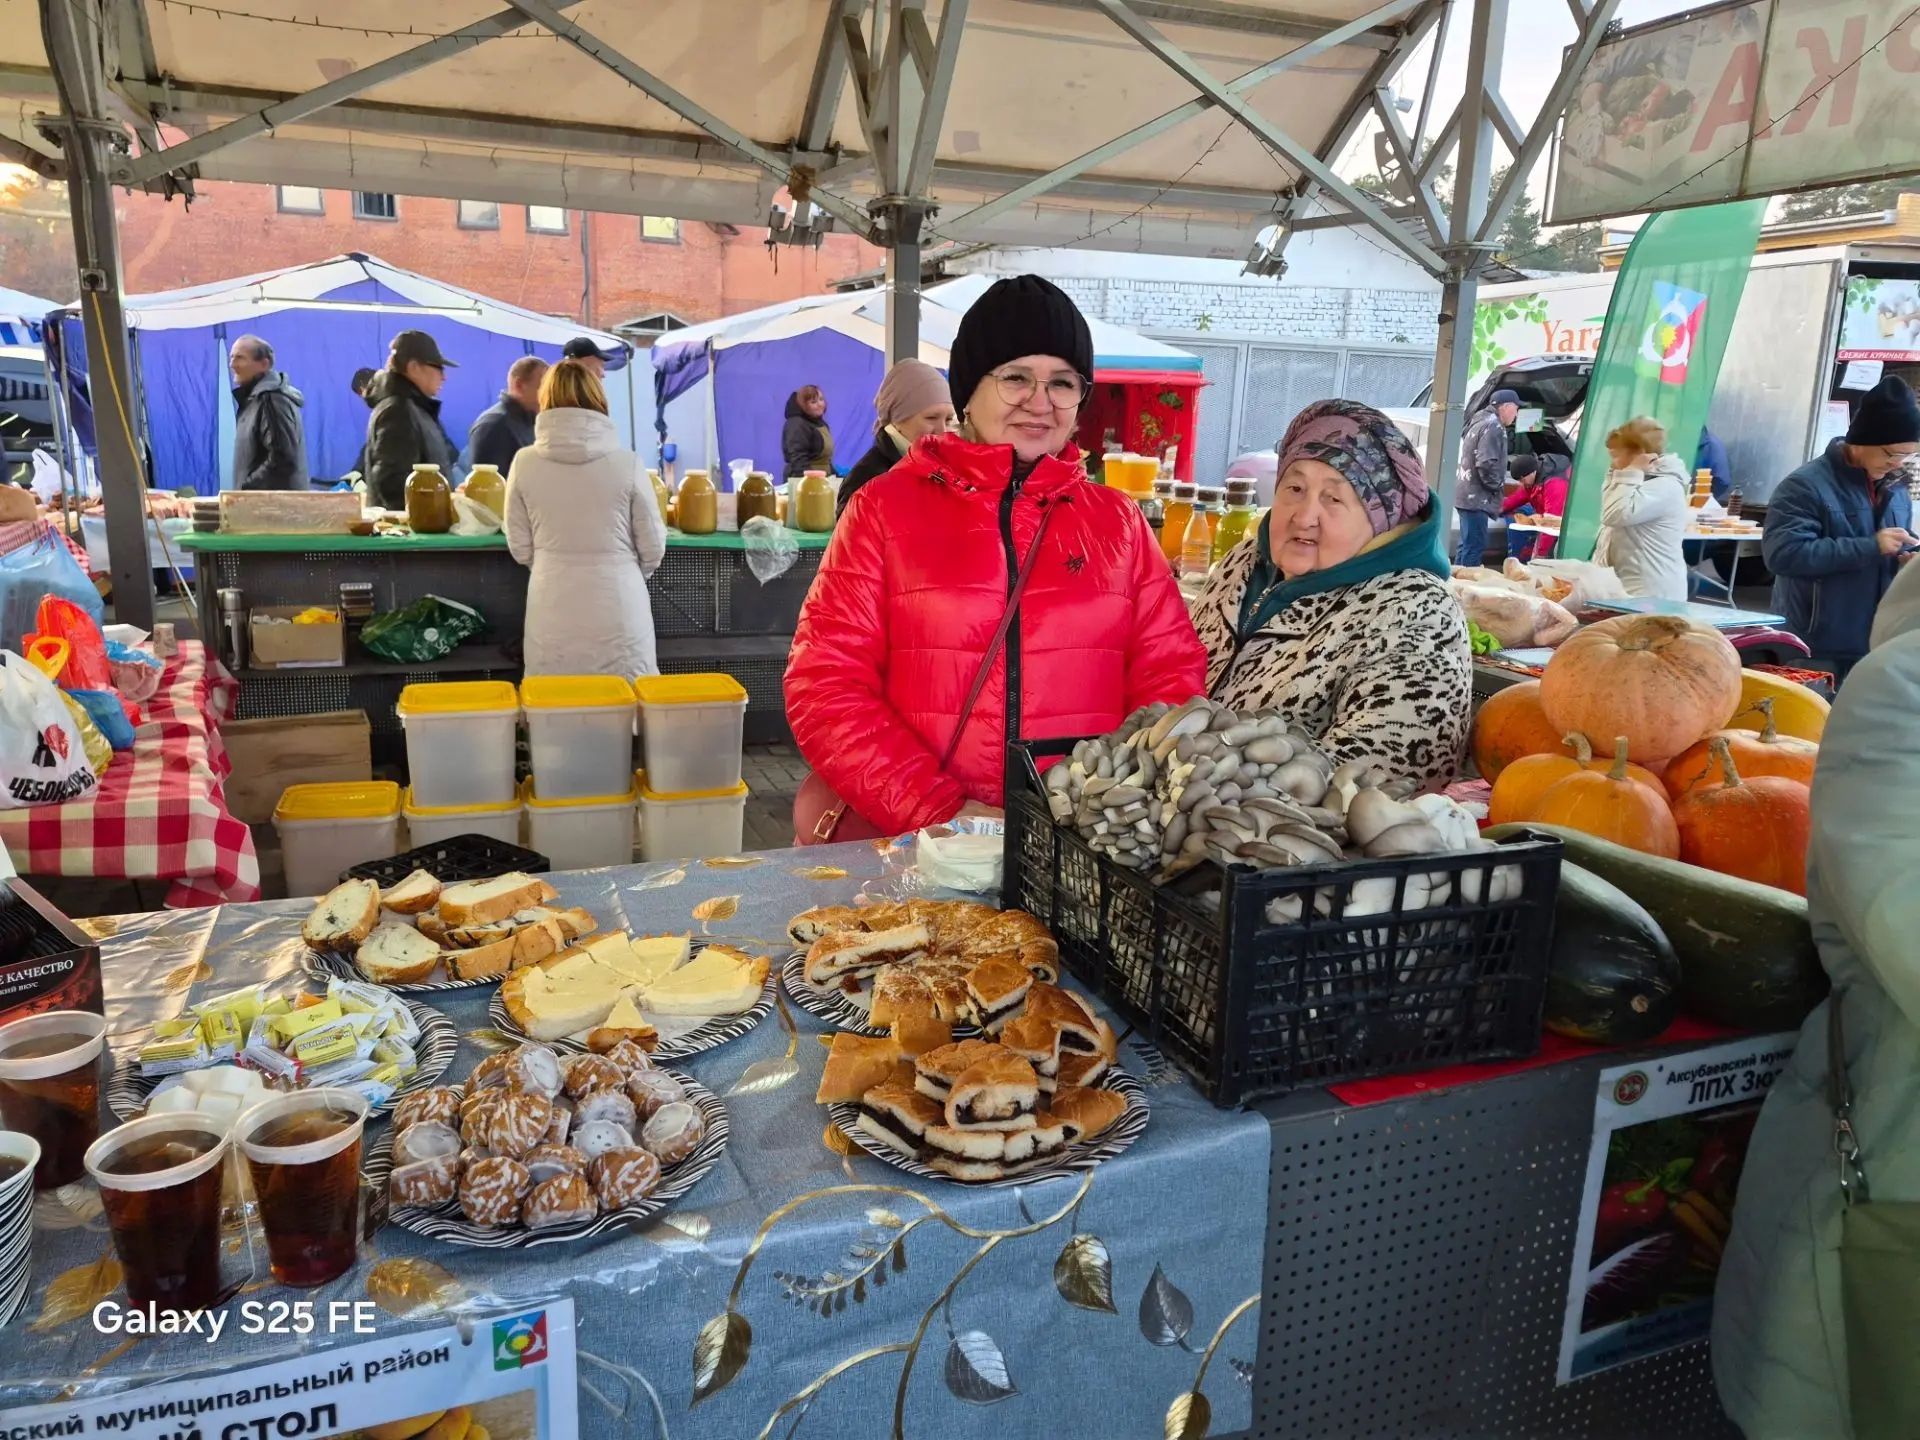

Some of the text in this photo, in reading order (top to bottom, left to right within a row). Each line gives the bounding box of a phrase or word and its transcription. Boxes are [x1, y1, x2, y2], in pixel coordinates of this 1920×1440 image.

[6, 959, 74, 984] КАЧЕСТВО
[1666, 1053, 1757, 1085] Аксубаевский
[1688, 1068, 1784, 1105] ЛПХ Зю
[96, 1361, 354, 1431] муниципальный
[364, 1347, 450, 1383] район
